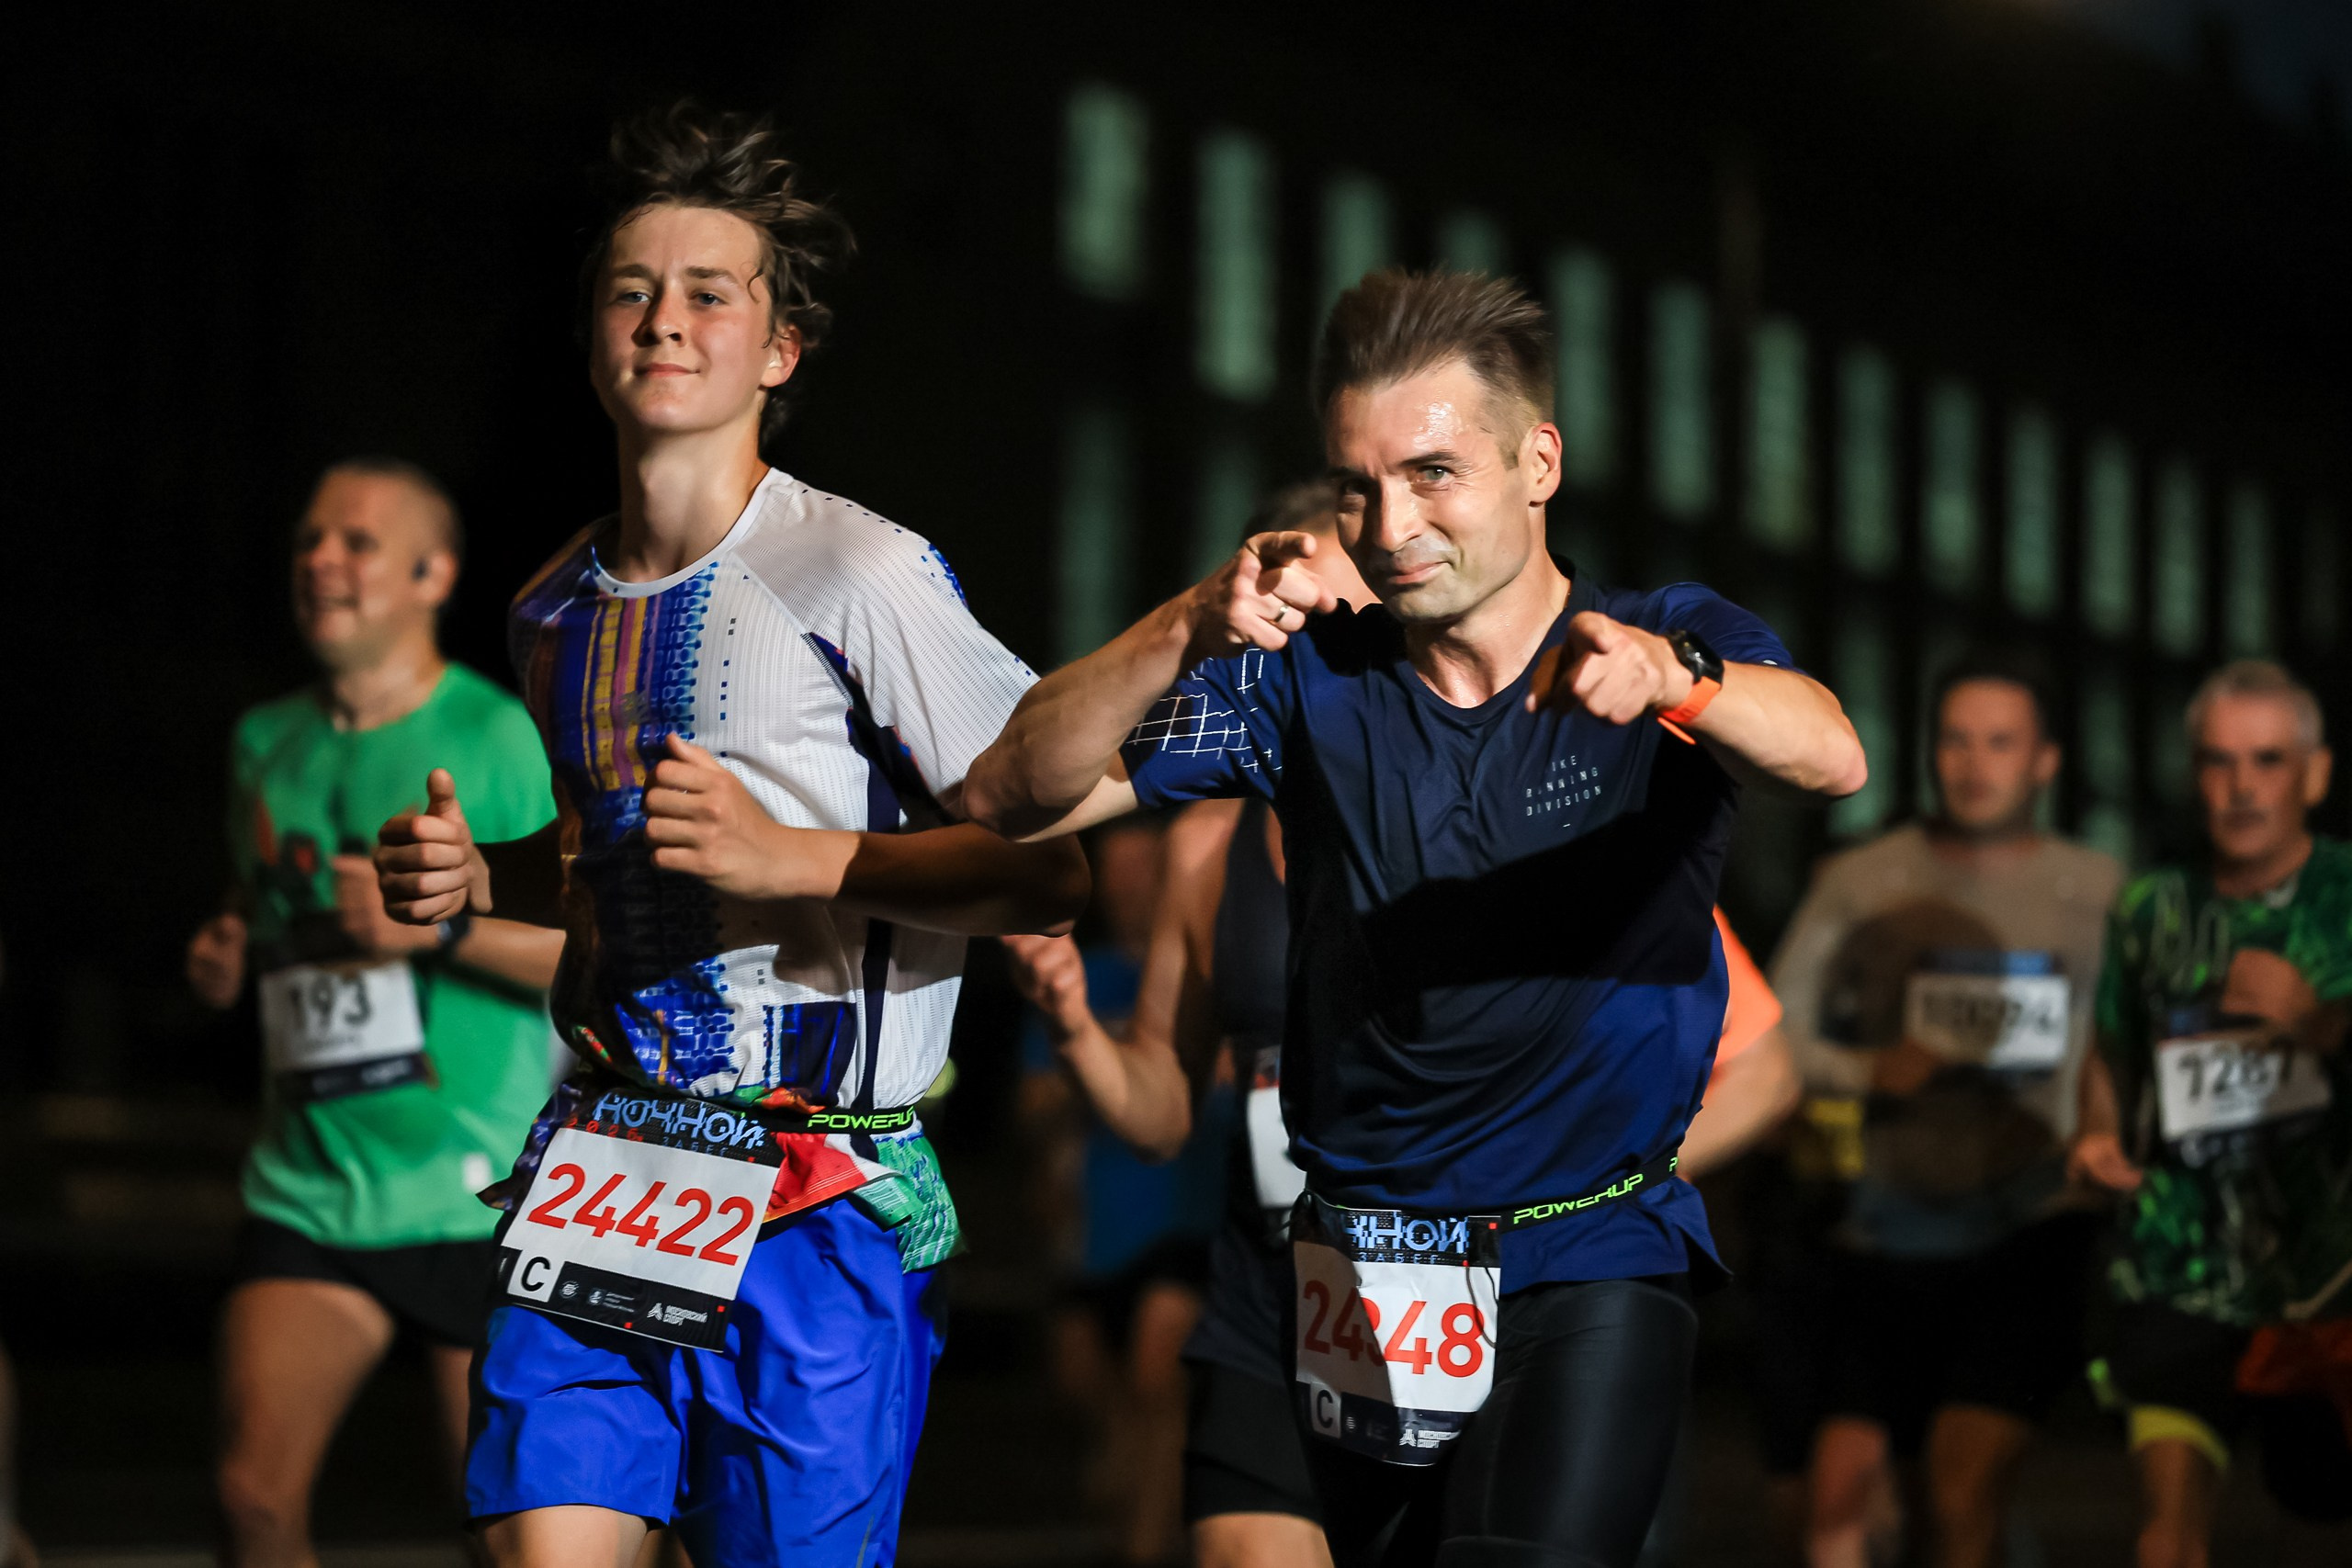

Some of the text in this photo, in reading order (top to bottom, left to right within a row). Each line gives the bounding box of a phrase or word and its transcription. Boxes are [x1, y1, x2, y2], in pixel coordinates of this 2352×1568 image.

[1552, 755, 1577, 772] IKE
[1526, 767, 1598, 797] RNNING
[1526, 785, 1600, 816] DIVISION
[1513, 1173, 1644, 1224] POWERUP
[526, 1163, 754, 1266] 24422
